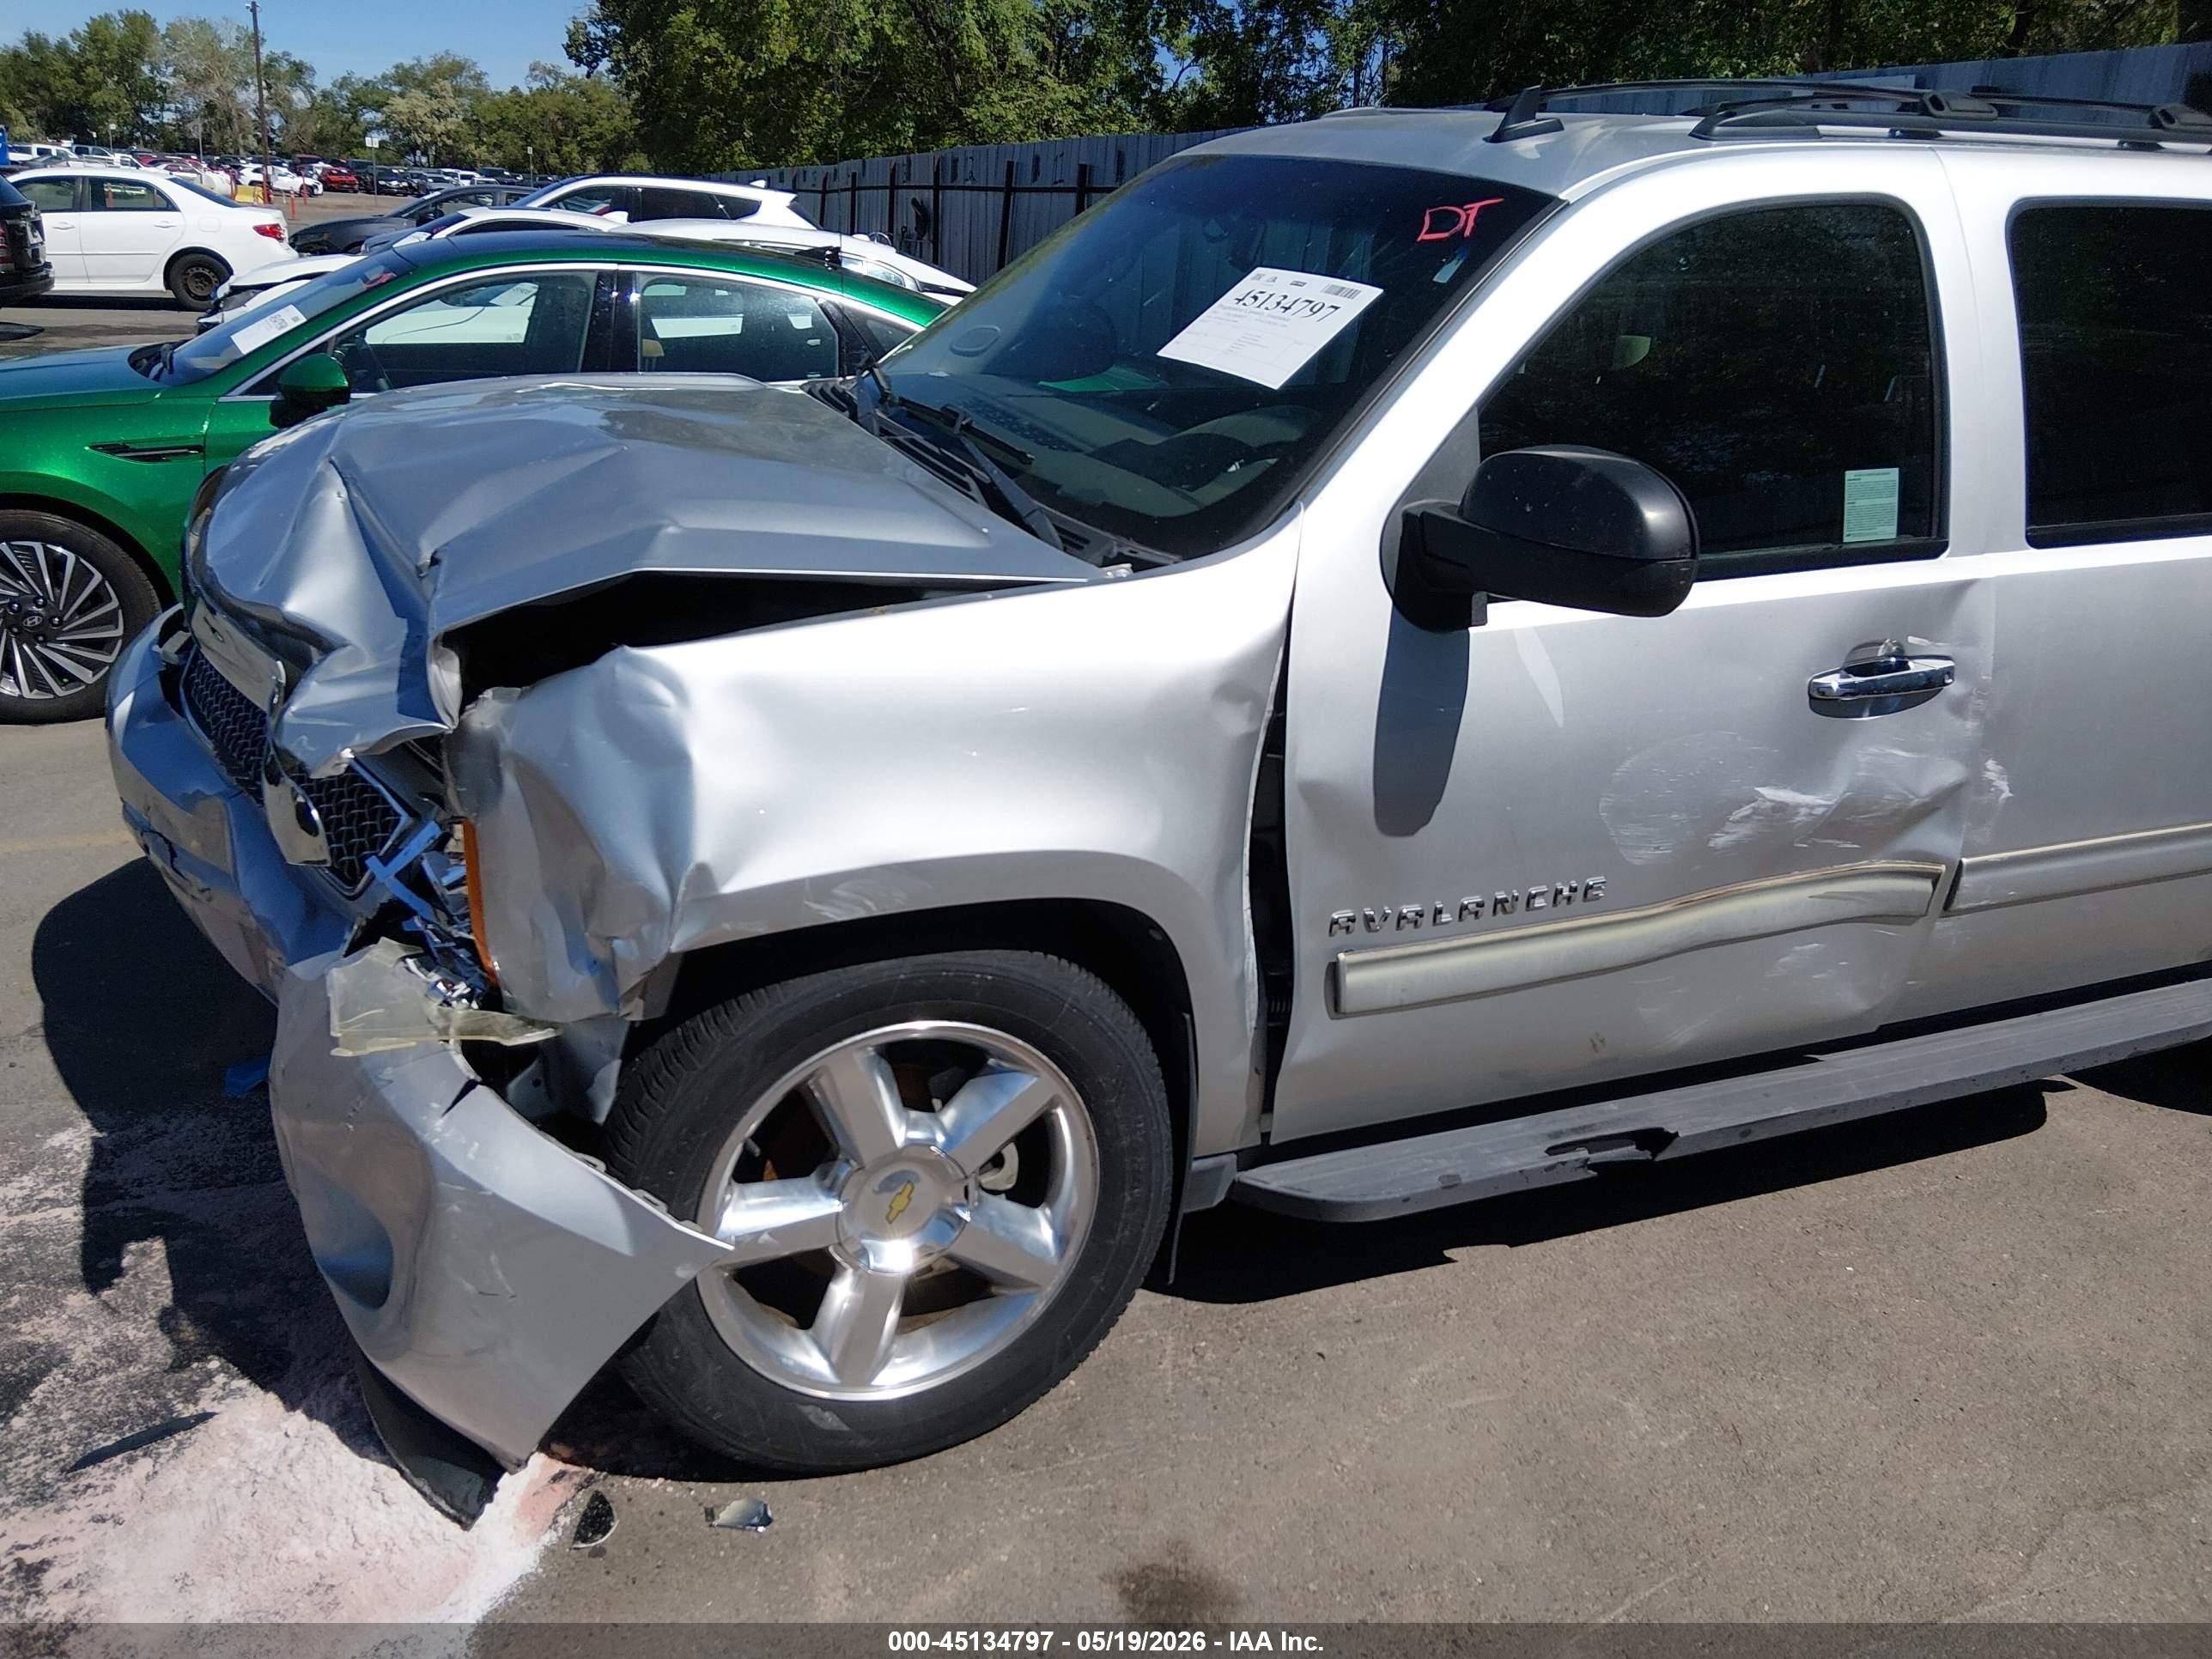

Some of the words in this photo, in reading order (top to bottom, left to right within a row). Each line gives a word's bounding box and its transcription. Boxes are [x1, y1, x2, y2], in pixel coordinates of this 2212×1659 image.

[1417, 198, 1505, 242] DT
[1234, 289, 1342, 323] 45134797
[1328, 875, 1607, 938] AVALANCHE
